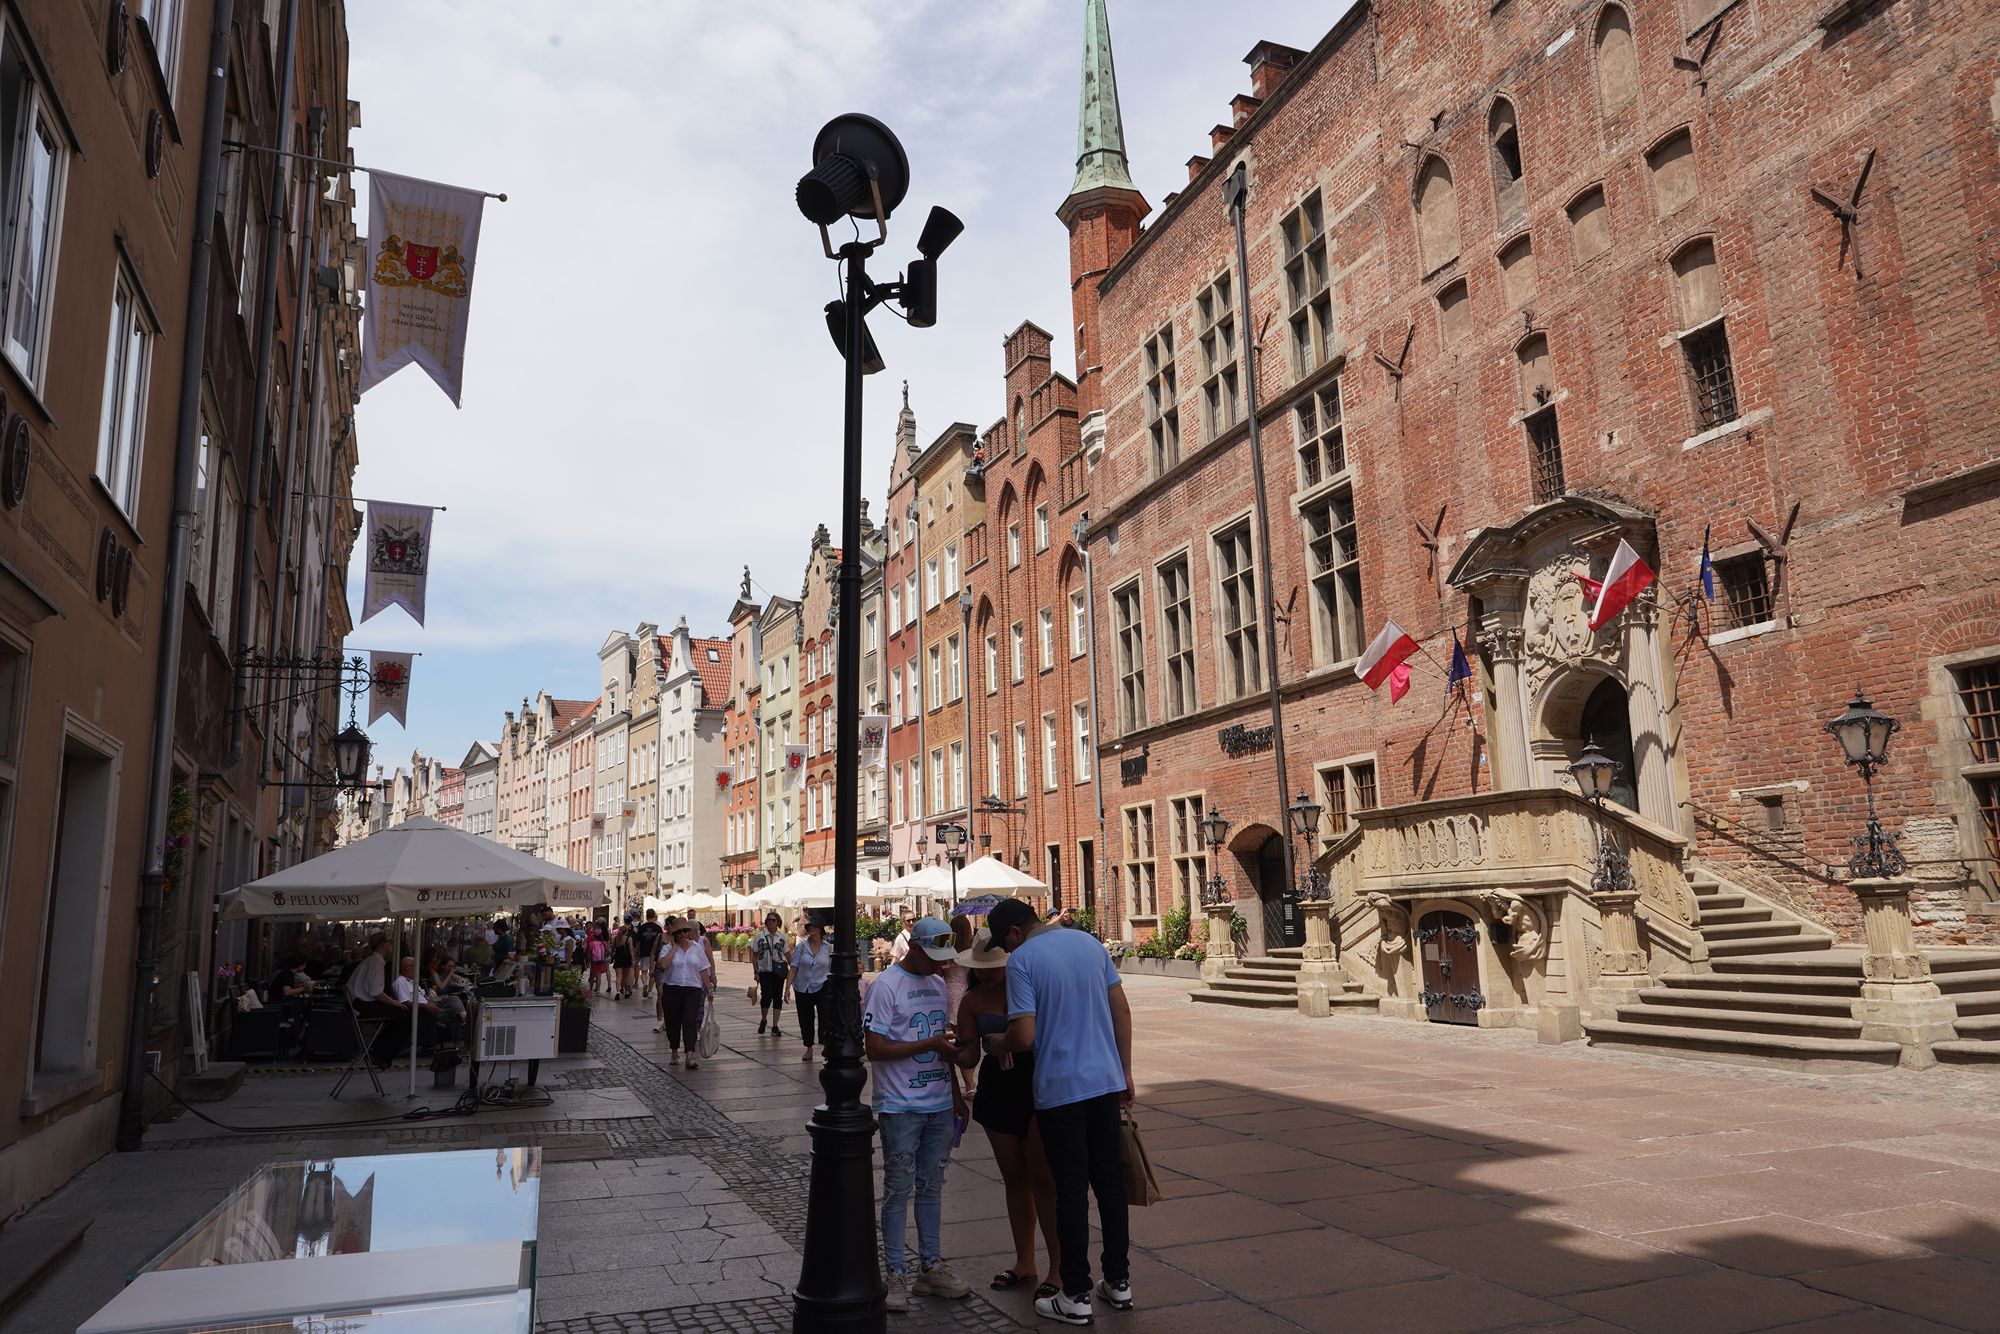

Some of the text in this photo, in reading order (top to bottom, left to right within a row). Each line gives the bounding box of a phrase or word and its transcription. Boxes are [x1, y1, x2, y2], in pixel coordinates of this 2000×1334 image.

[290, 894, 361, 906] PELLOWSKI
[435, 887, 512, 901] PELLOWSKI
[559, 889, 593, 901] PELLOWSKI
